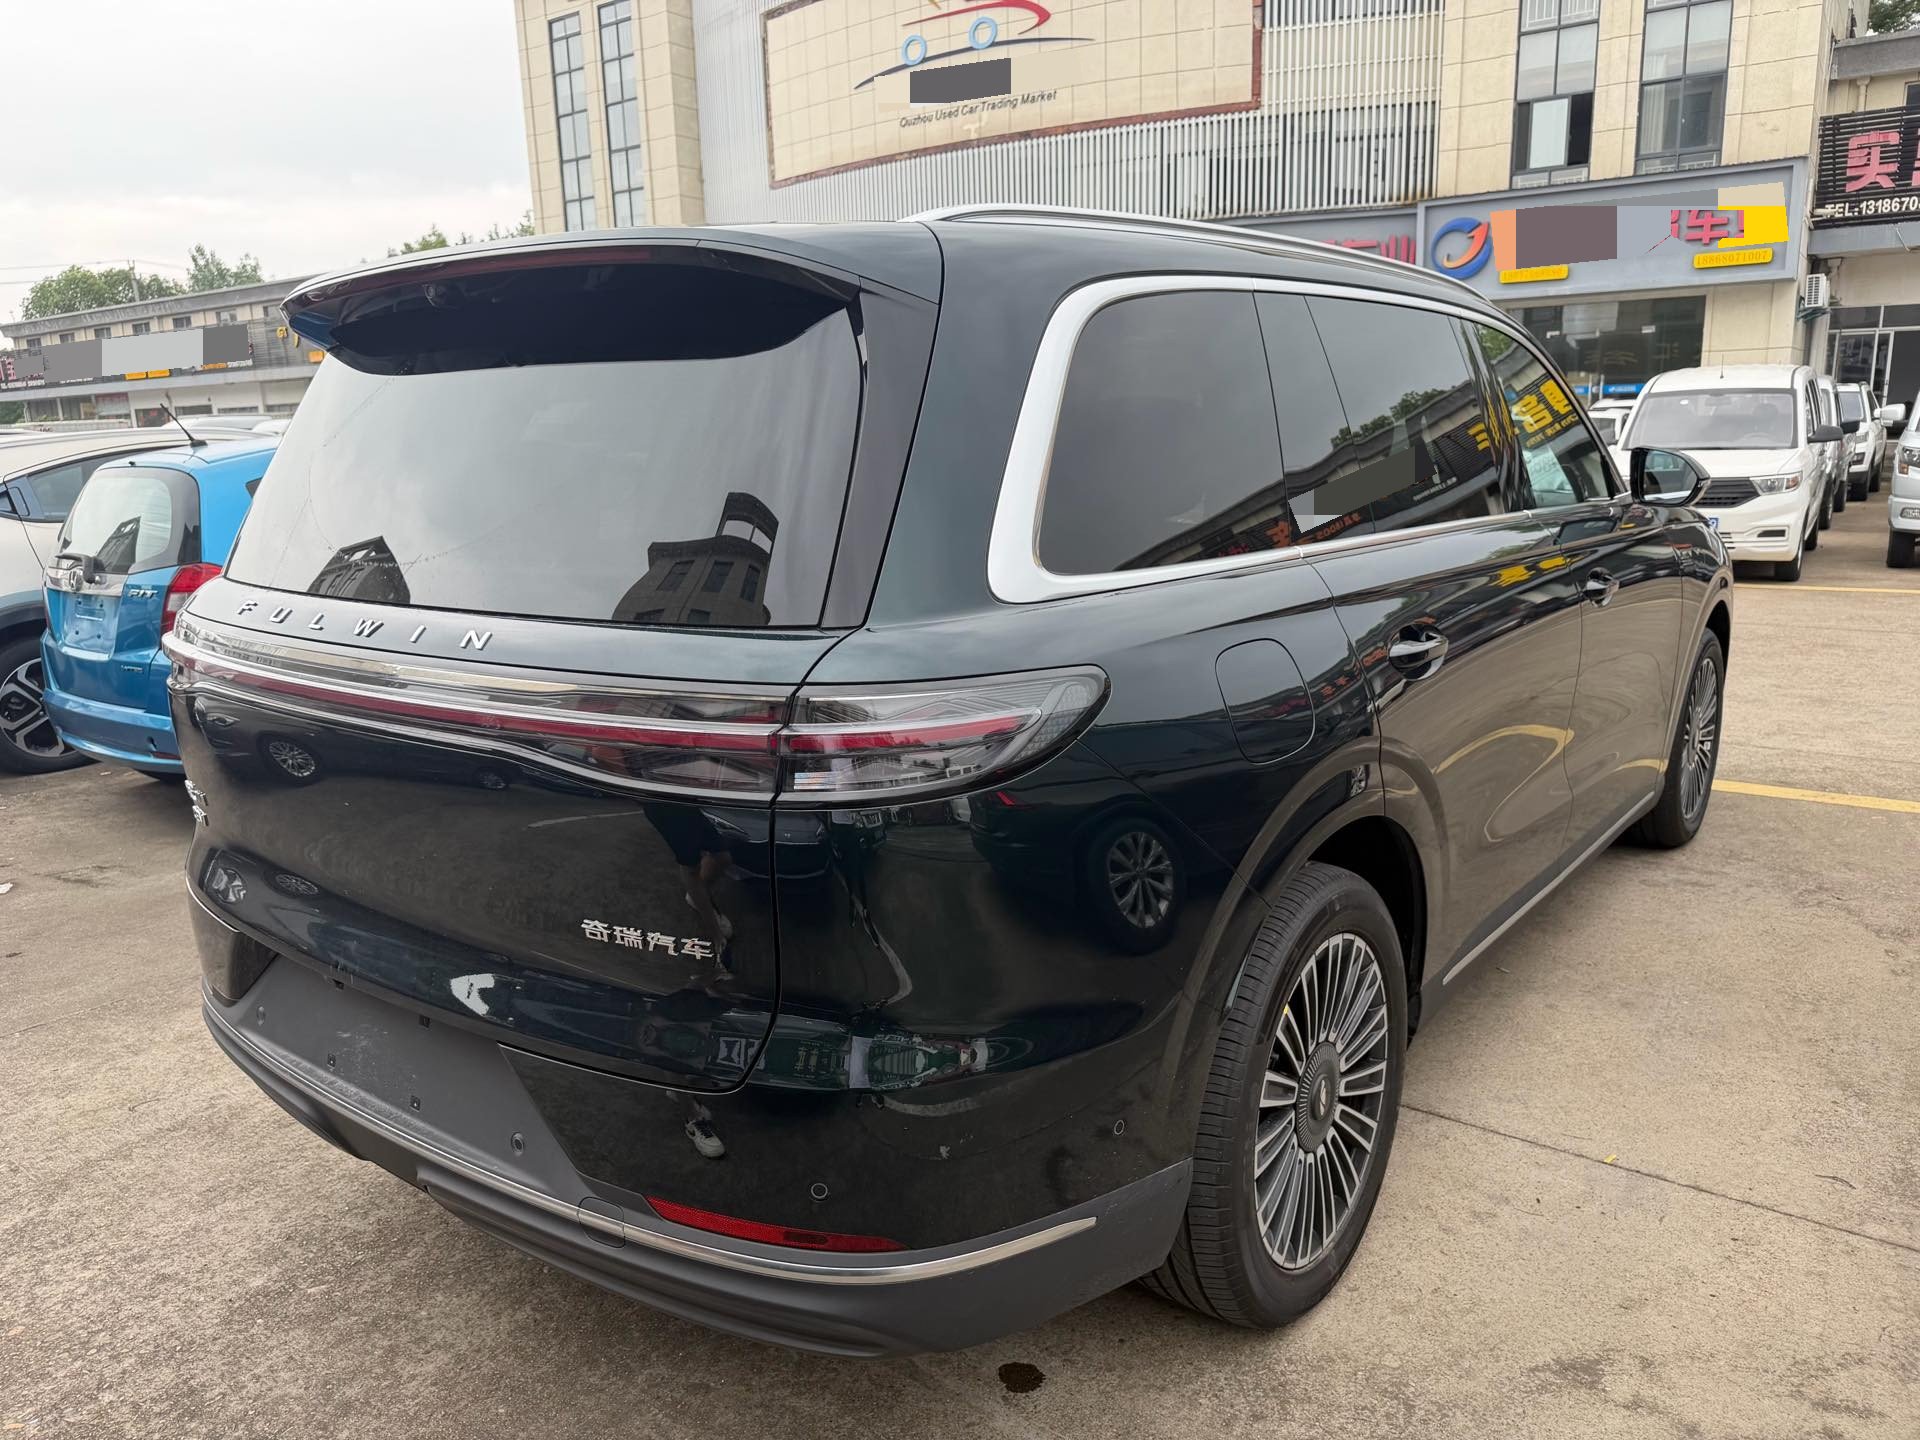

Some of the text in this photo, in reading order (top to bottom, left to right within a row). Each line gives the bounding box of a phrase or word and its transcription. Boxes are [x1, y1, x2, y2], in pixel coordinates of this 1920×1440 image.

[934, 107, 960, 121] Used
[961, 104, 979, 117] Car
[980, 98, 1018, 110] Trading
[1021, 90, 1057, 105] Market
[128, 588, 158, 599] FIT
[237, 600, 493, 651] FULWIN
[580, 918, 715, 960] 奇瑞汽车
